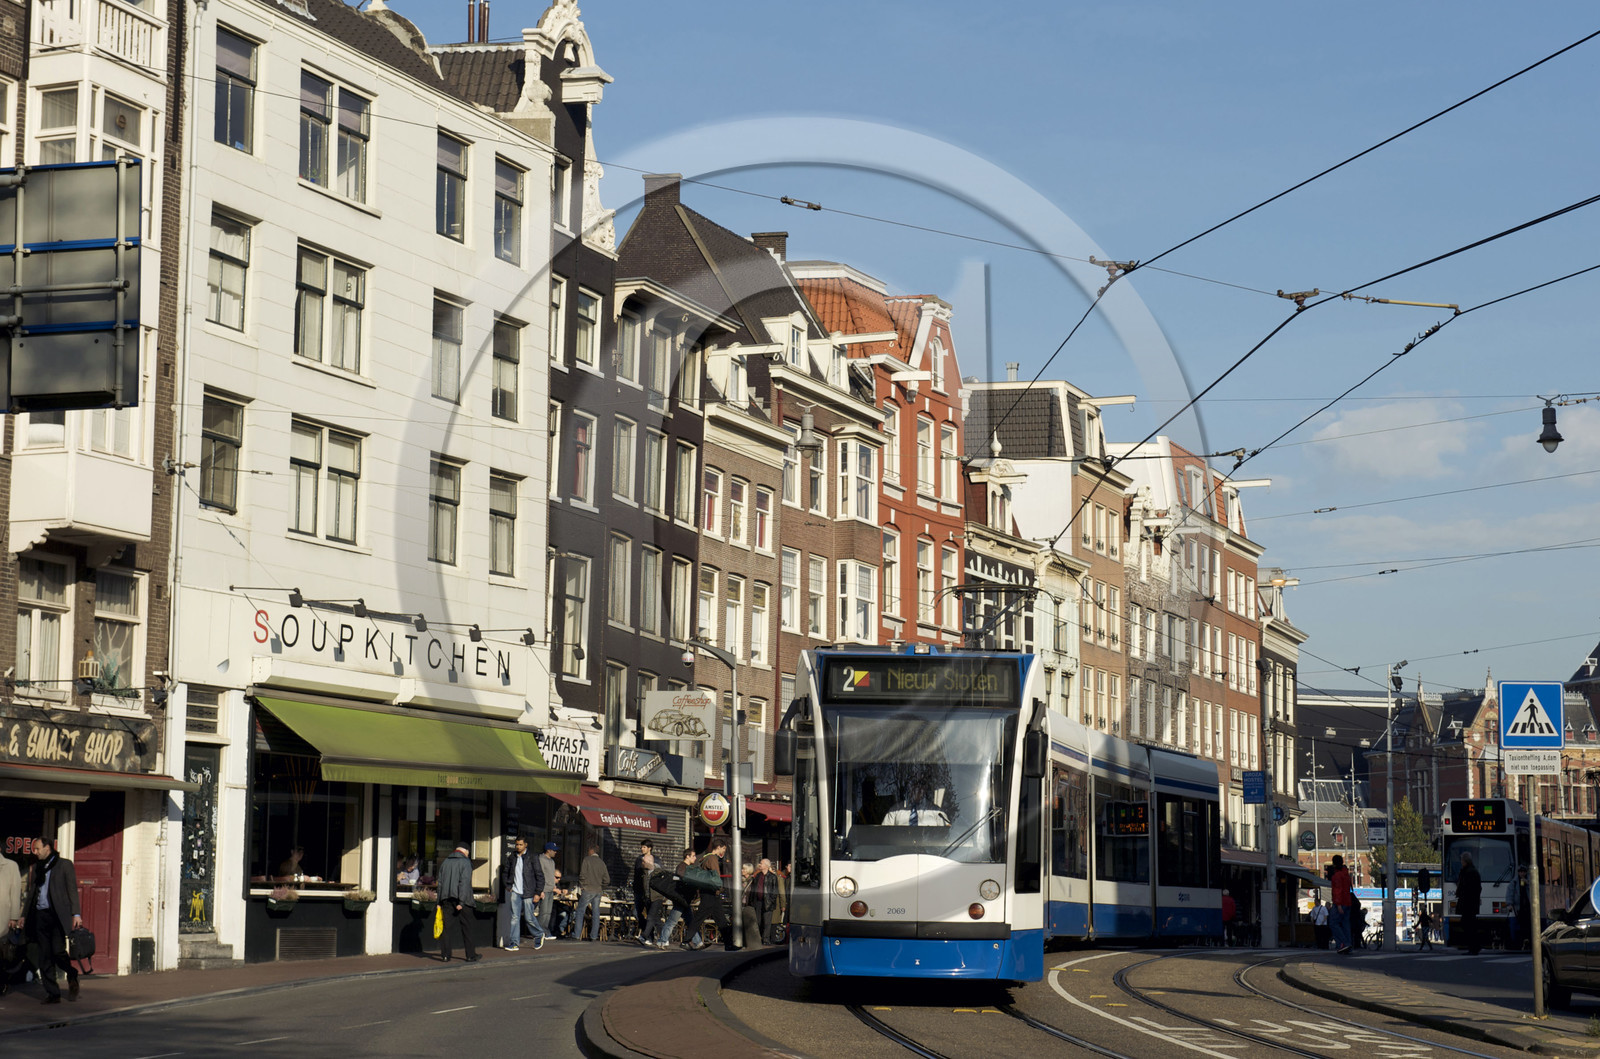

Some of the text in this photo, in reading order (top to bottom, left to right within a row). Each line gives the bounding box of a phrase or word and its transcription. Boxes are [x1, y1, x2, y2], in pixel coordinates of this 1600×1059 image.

[253, 608, 512, 681] SOUPKITCHEN
[842, 665, 998, 692] 2 Nieuw Sloten
[672, 692, 712, 710] Coffeeshop
[8, 723, 124, 765] & SMART SHOP
[550, 754, 590, 774] DINNER
[617, 749, 639, 777] Café
[1468, 803, 1476, 817] 5
[599, 813, 652, 829] English Breakfast
[886, 907, 906, 915] 2069
